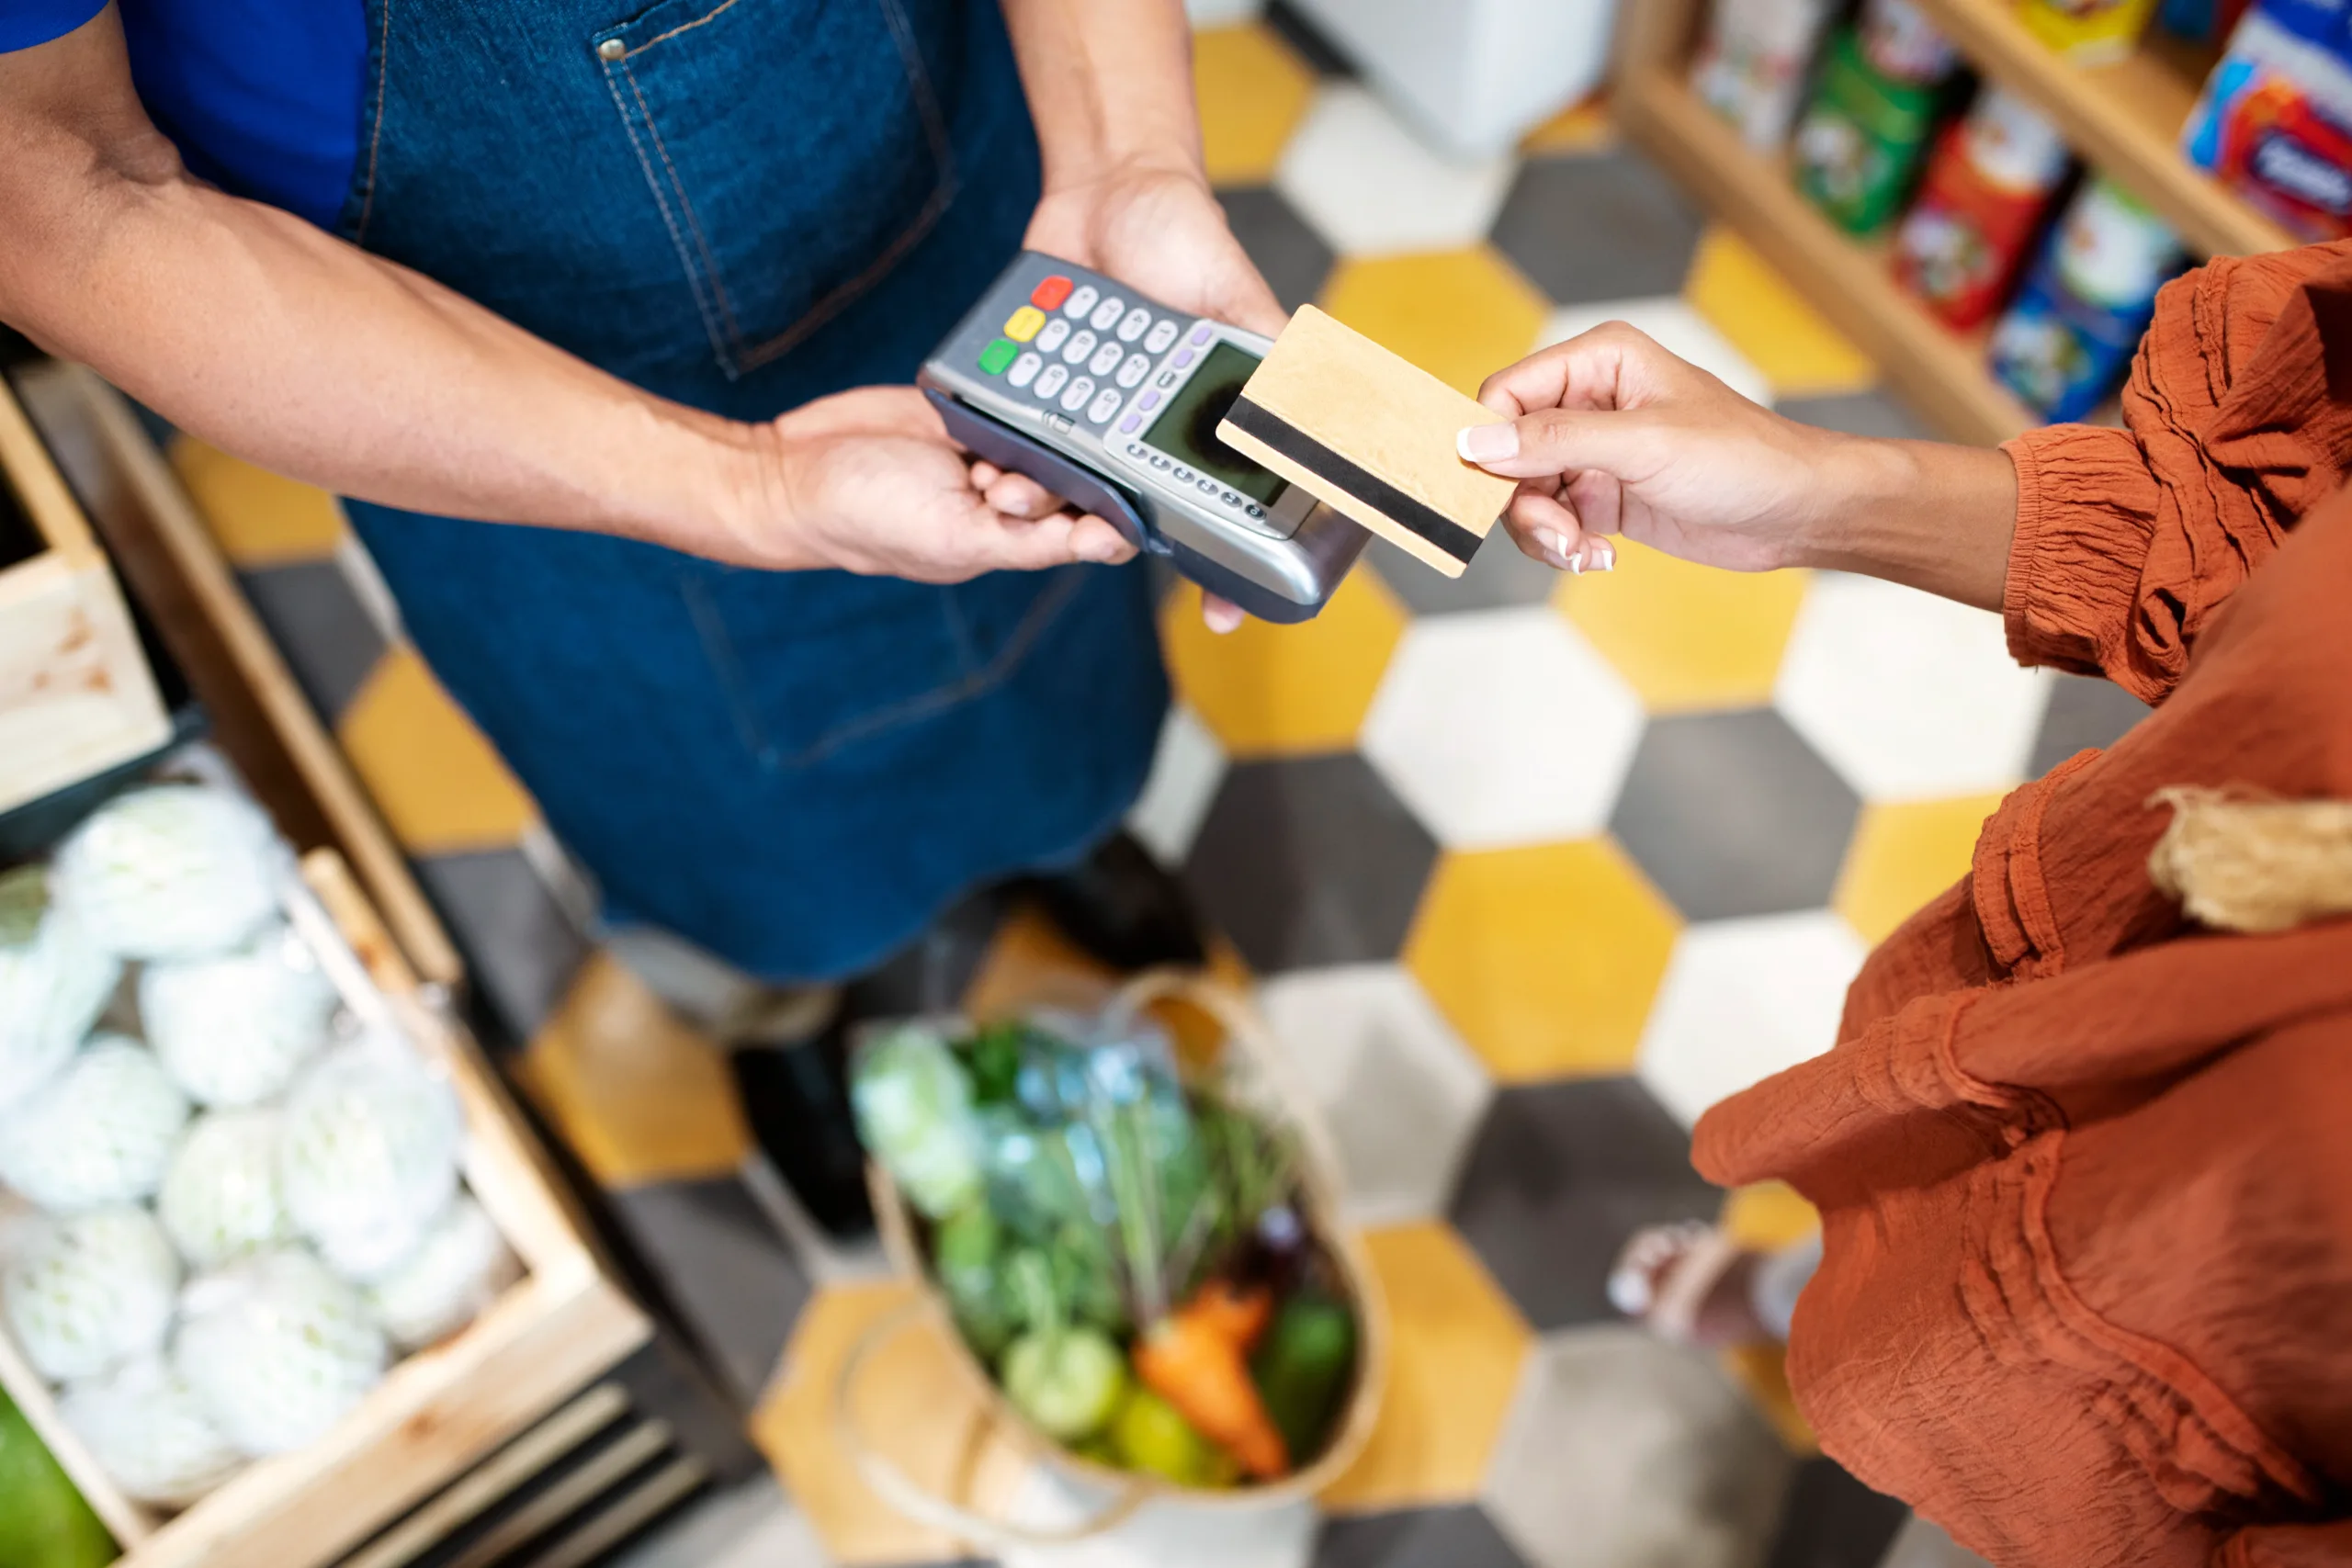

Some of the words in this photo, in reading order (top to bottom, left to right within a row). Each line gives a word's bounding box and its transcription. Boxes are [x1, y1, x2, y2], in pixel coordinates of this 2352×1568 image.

[1133, 315, 1144, 323] 4
[1133, 359, 1146, 369] 2
[1077, 381, 1090, 390] 6
[1103, 392, 1117, 403] 3
